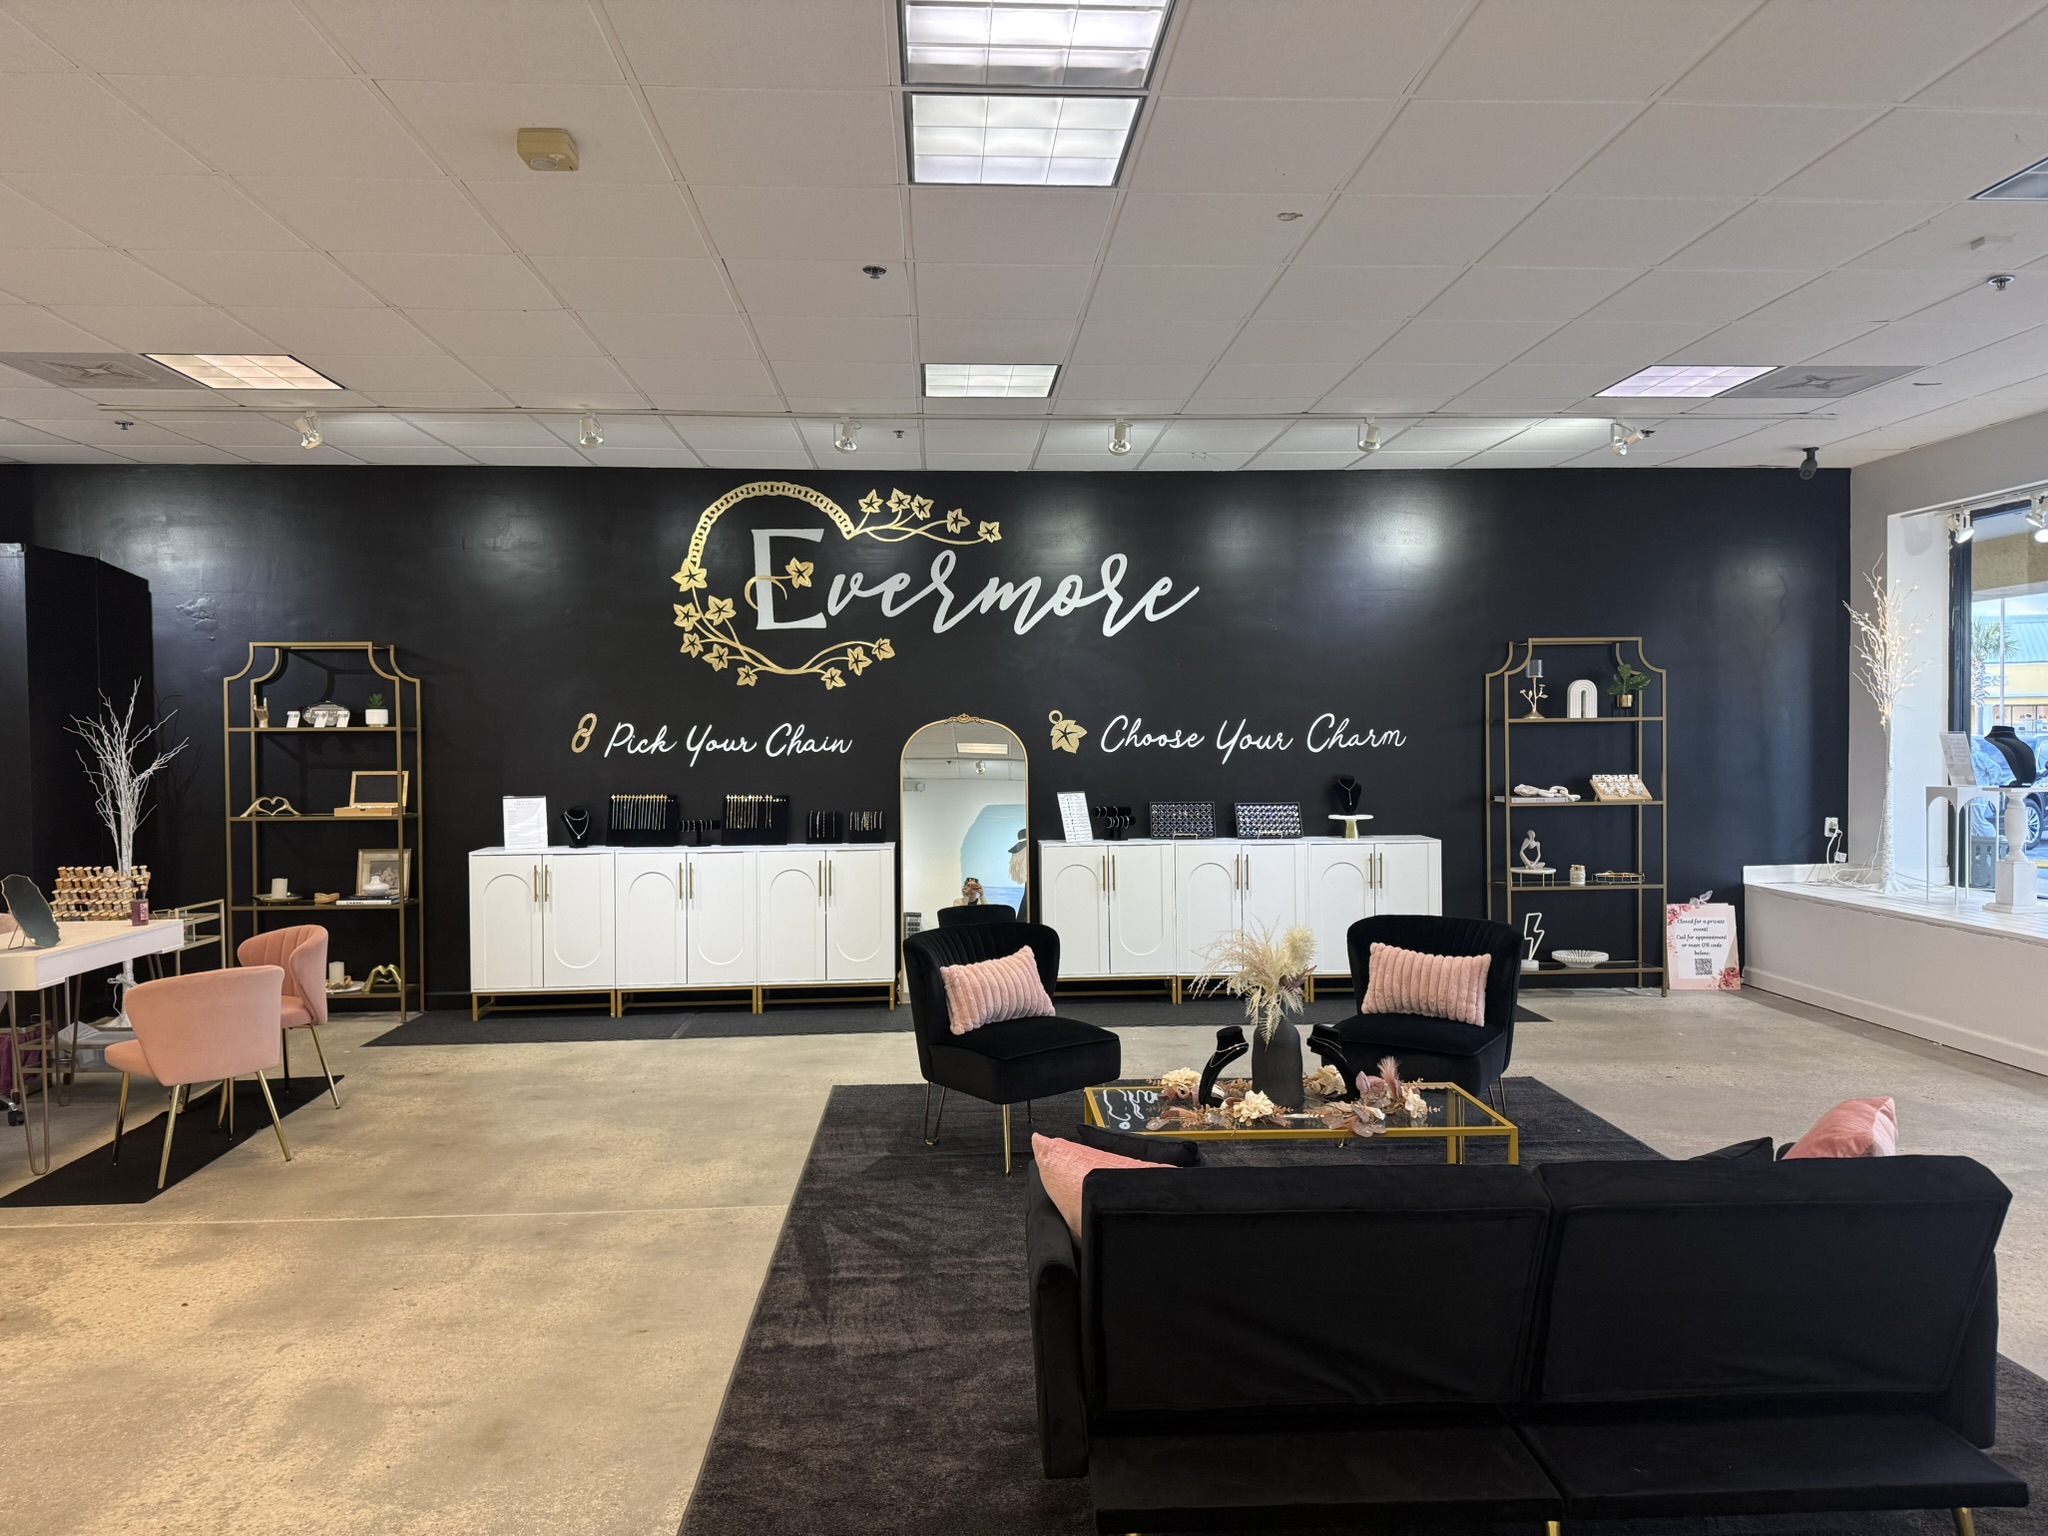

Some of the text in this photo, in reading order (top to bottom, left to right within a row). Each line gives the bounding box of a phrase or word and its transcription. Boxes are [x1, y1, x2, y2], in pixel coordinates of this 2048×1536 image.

[751, 528, 1200, 638] Evermore
[603, 722, 853, 767] Pick Your Chain
[1100, 712, 1407, 765] Choose Your Charm
[1686, 934, 1694, 942] for
